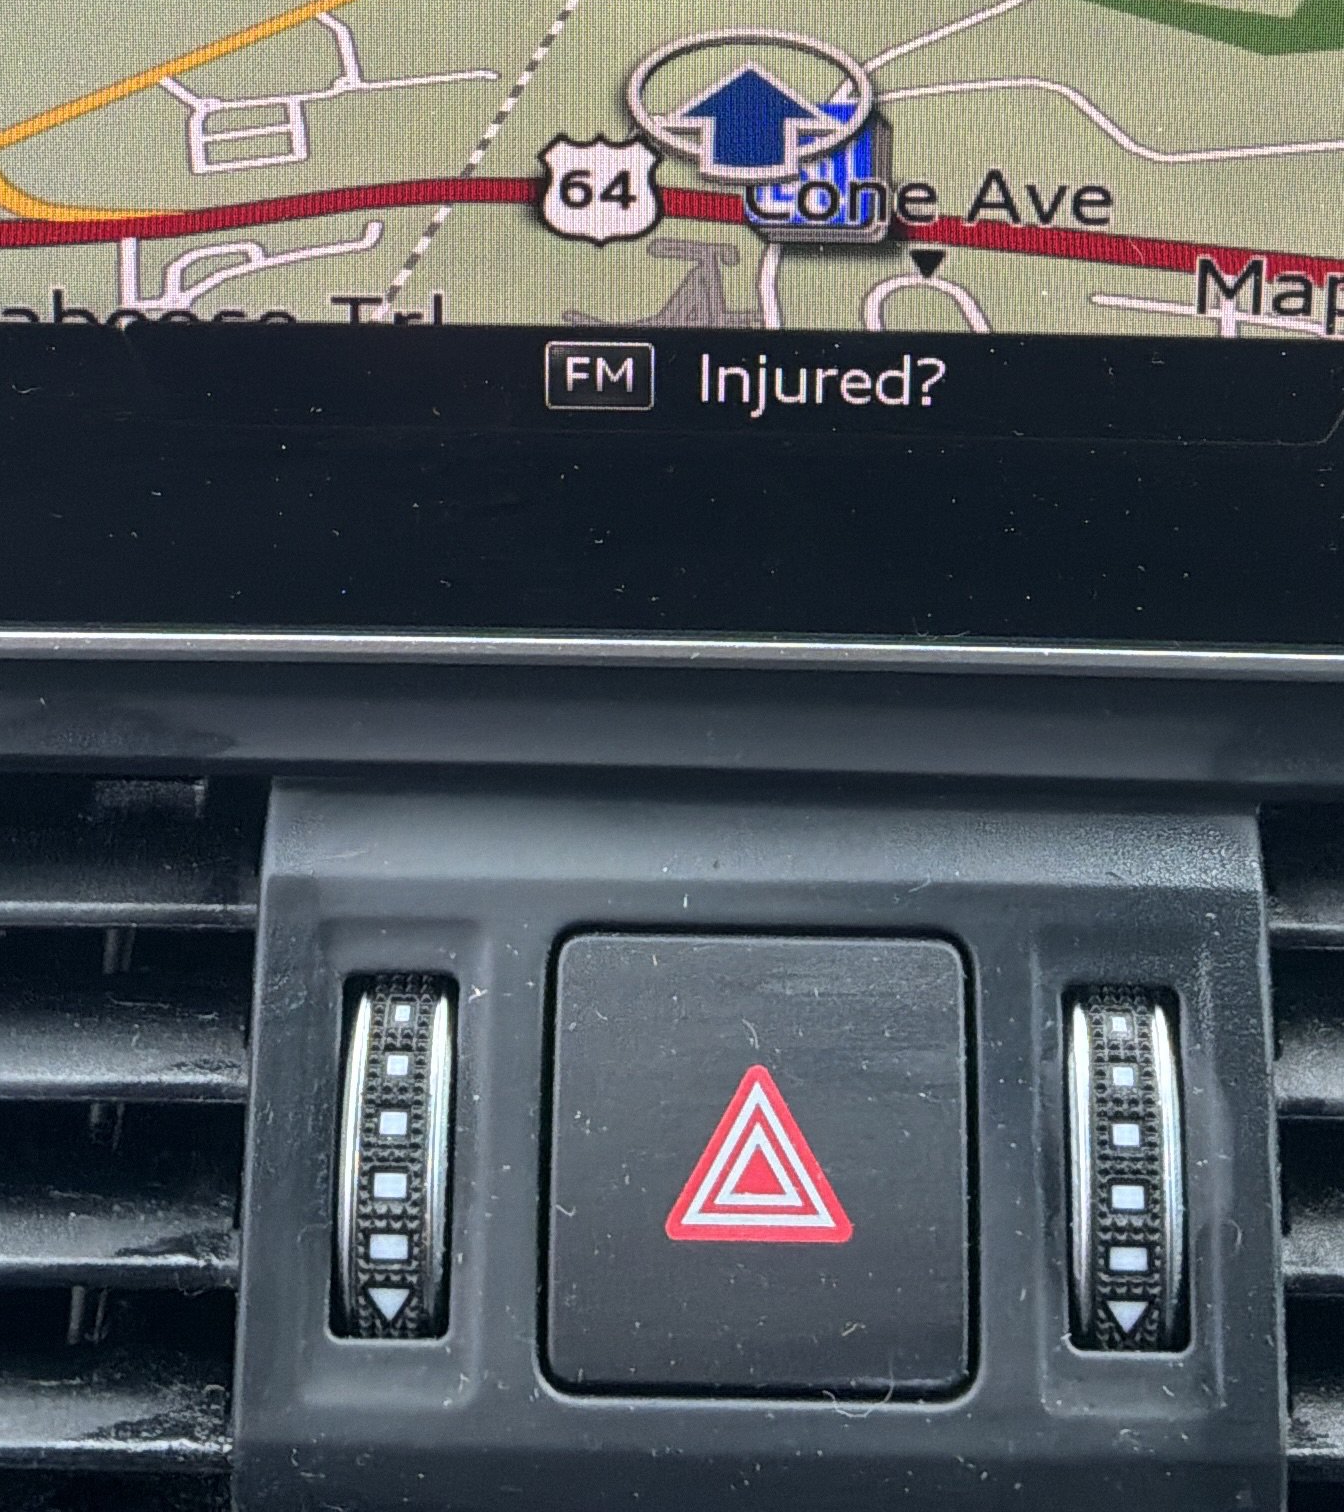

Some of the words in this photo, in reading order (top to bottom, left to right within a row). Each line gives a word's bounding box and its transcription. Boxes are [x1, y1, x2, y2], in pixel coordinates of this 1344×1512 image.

[560, 170, 637, 210] 64
[967, 169, 1113, 226] Ave
[565, 358, 635, 393] FM
[700, 355, 946, 418] Injured?
